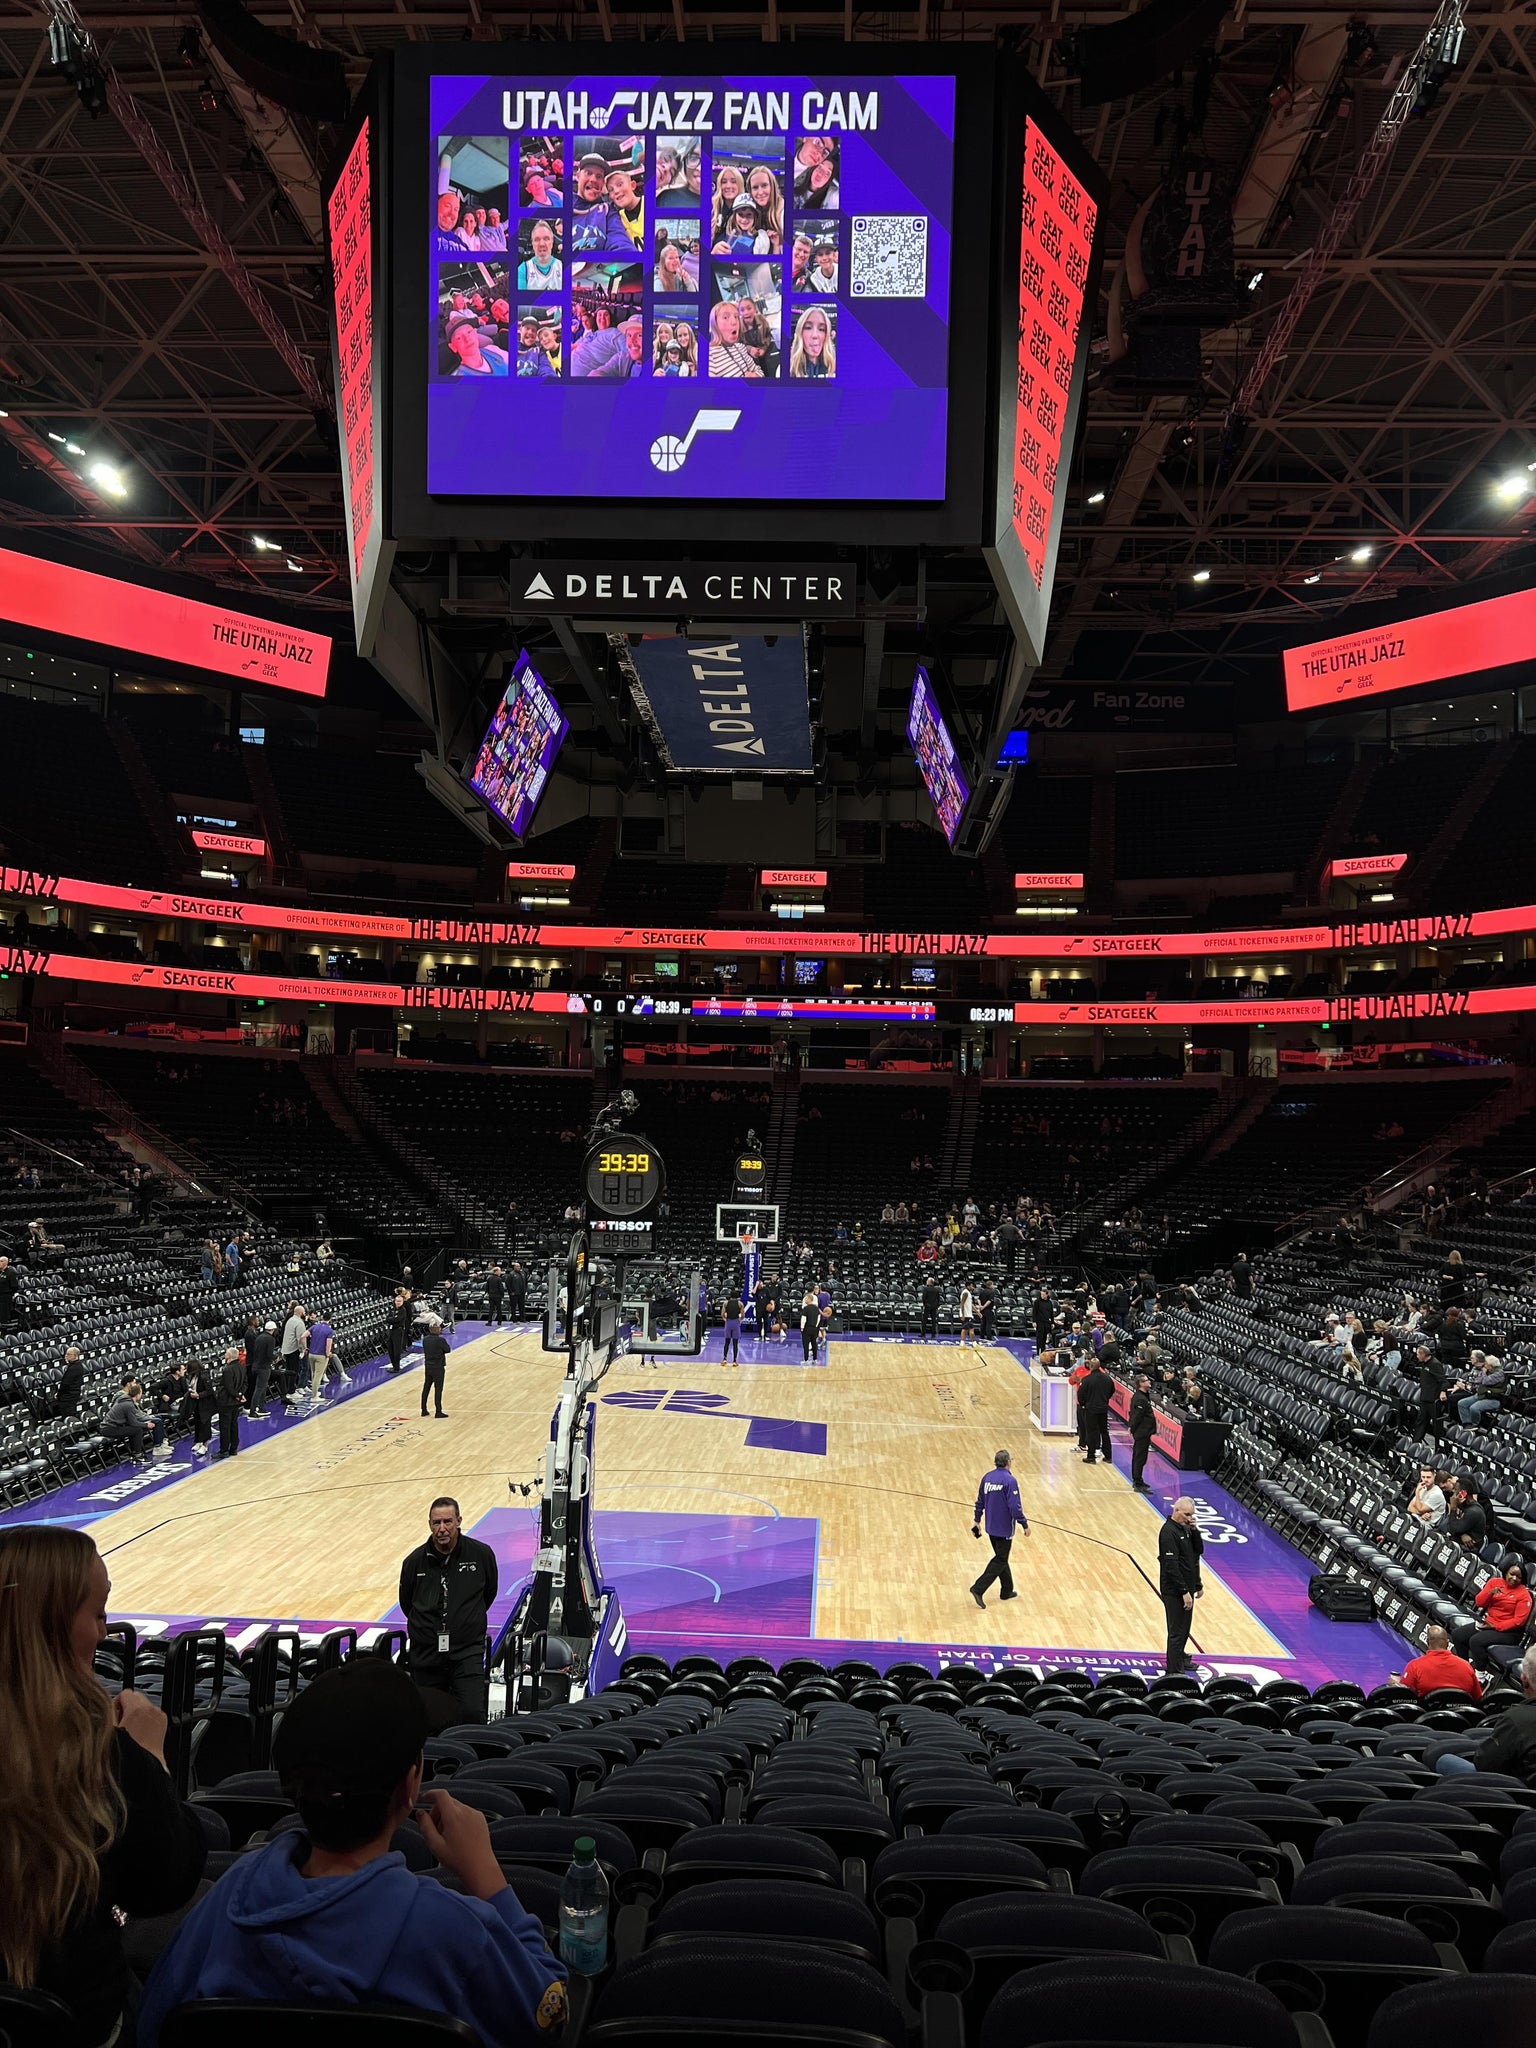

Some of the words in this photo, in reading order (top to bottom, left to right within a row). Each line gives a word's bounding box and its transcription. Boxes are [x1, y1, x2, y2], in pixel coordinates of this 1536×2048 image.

[502, 91, 588, 130] UTAH
[627, 91, 713, 130] JAZZ
[724, 91, 789, 130] FAN
[802, 91, 879, 130] CAM
[1035, 138, 1056, 176] SEAT
[1032, 158, 1054, 199] GEEK
[1061, 173, 1081, 208] SEAT
[1059, 192, 1079, 230] GEEK
[1043, 210, 1063, 245] SEAT
[1176, 171, 1212, 276] UTAH
[1040, 229, 1061, 267] GEEK
[1068, 242, 1087, 275] SEAT
[1024, 249, 1045, 284] SEAT
[1065, 261, 1086, 294] GEEK
[1022, 268, 1043, 306] GEEK
[1050, 280, 1070, 313] SEAT
[1048, 299, 1068, 335] GEEK
[1032, 319, 1052, 353] SEAT
[1030, 339, 1050, 374] GEEK
[1040, 387, 1058, 419] SEAT
[1037, 406, 1056, 440] GEEK
[1022, 428, 1041, 459] SEAT
[1020, 448, 1039, 481] GEEK
[1029, 495, 1046, 524] SEAT
[1026, 514, 1045, 545] GEEK
[566, 575, 688, 599] DELTA
[704, 575, 843, 600] CENTER
[224, 617, 247, 629] OFFICIAL
[248, 624, 275, 636] TICKETING
[275, 630, 297, 641] PARTNER
[212, 624, 239, 645] THE
[241, 631, 277, 655] UTAH
[279, 642, 314, 664] JAZZ
[1311, 647, 1334, 658] OFFICIAL
[1334, 640, 1361, 652] TICKETING
[1361, 635, 1385, 646] PARTNER
[1386, 632, 1393, 640] OF
[263, 663, 279, 672] SEAT
[1302, 658, 1328, 679] THE
[1330, 649, 1367, 672] UTAH
[1370, 640, 1406, 663] JAZZ
[262, 669, 278, 679] GEEK
[1357, 674, 1373, 683] SEAT
[1357, 680, 1374, 689] GEEK
[687, 642, 755, 734] DELTA
[1093, 692, 1130, 708] Fan
[1135, 692, 1185, 708] Zone
[203, 835, 254, 851] SEATGEEK
[519, 865, 565, 877] SEATGEEK
[1344, 857, 1395, 871] SEATGEEK
[10, 868, 61, 899] JAZZ
[771, 872, 817, 883] SEATGEEK
[1026, 875, 1073, 886] SEATGEEK
[171, 898, 244, 920] SEATGEEK
[286, 915, 320, 926] OFFICIAL
[321, 917, 361, 929] TICKETING
[362, 920, 395, 931] PARTNER
[396, 923, 405, 932] OF
[408, 919, 441, 940] THE
[446, 920, 493, 943] UTAH
[497, 925, 541, 945] JAZZ
[641, 932, 708, 947] SEATGEEK
[1204, 938, 1238, 948] OFFICIAL
[1239, 936, 1279, 946] TICKETING
[1280, 934, 1314, 944] PARTNER
[1315, 933, 1326, 942] OF
[1328, 926, 1364, 947] THE
[1368, 920, 1416, 944] UTAH
[1424, 915, 1473, 940] JAZZ
[745, 936, 777, 946] OFFICIAL
[778, 936, 814, 947] TICKETING
[815, 938, 846, 947] PARTNER
[847, 938, 856, 947] OF
[859, 933, 891, 953] THE
[895, 934, 941, 953] UTAH
[945, 935, 988, 955] JAZZ
[1092, 938, 1162, 952] SEATGEEK
[1, 948, 50, 975] JAZZ
[163, 971, 236, 991] SEATGEEK
[278, 984, 312, 994] OFFICIAL
[313, 986, 353, 997] TICKETING
[354, 988, 387, 999] PARTNER
[388, 991, 398, 1000] OF
[401, 986, 434, 1007] THE
[439, 988, 485, 1010] UTAH
[491, 990, 535, 1012] JAZZ
[594, 999, 602, 1012] 0
[617, 999, 626, 1013] 0
[655, 1001, 680, 1014] 39:39
[1200, 1008, 1233, 1017] OFFICIAL
[1235, 1007, 1275, 1017] TICKETING
[1276, 1006, 1310, 1016] PARTNER
[1311, 1006, 1321, 1015] OF
[1325, 999, 1361, 1020] THE
[1365, 995, 1415, 1019] UTAH
[1421, 992, 1470, 1017] JAZZ
[970, 1008, 996, 1022] 06:23
[998, 1008, 1013, 1022] PM
[1088, 1007, 1157, 1021] SEATGEEK
[598, 1153, 649, 1173] 39:39
[741, 1160, 762, 1170] 39:39
[606, 1220, 653, 1231] TISSOT
[77, 1462, 193, 1502] SEATGEEK
[984, 1482, 1004, 1495] UTAH
[1454, 1564, 1467, 1577] GEEK
[1458, 1556, 1471, 1568] SEAT
[1473, 1576, 1487, 1589] GEEK
[1478, 1568, 1491, 1581] SEAT
[1373, 1594, 1384, 1608] GEEK
[1376, 1586, 1388, 1599] SEAT
[1385, 1606, 1397, 1620] GEEK
[1390, 1599, 1401, 1611] SEAT
[1402, 1619, 1415, 1633] GEEK
[1407, 1611, 1420, 1623] SEAT
[938, 1649, 995, 1661] UTAH
[1001, 1653, 1033, 1663] OF
[1038, 1655, 1166, 1667] UNIVERSITY
